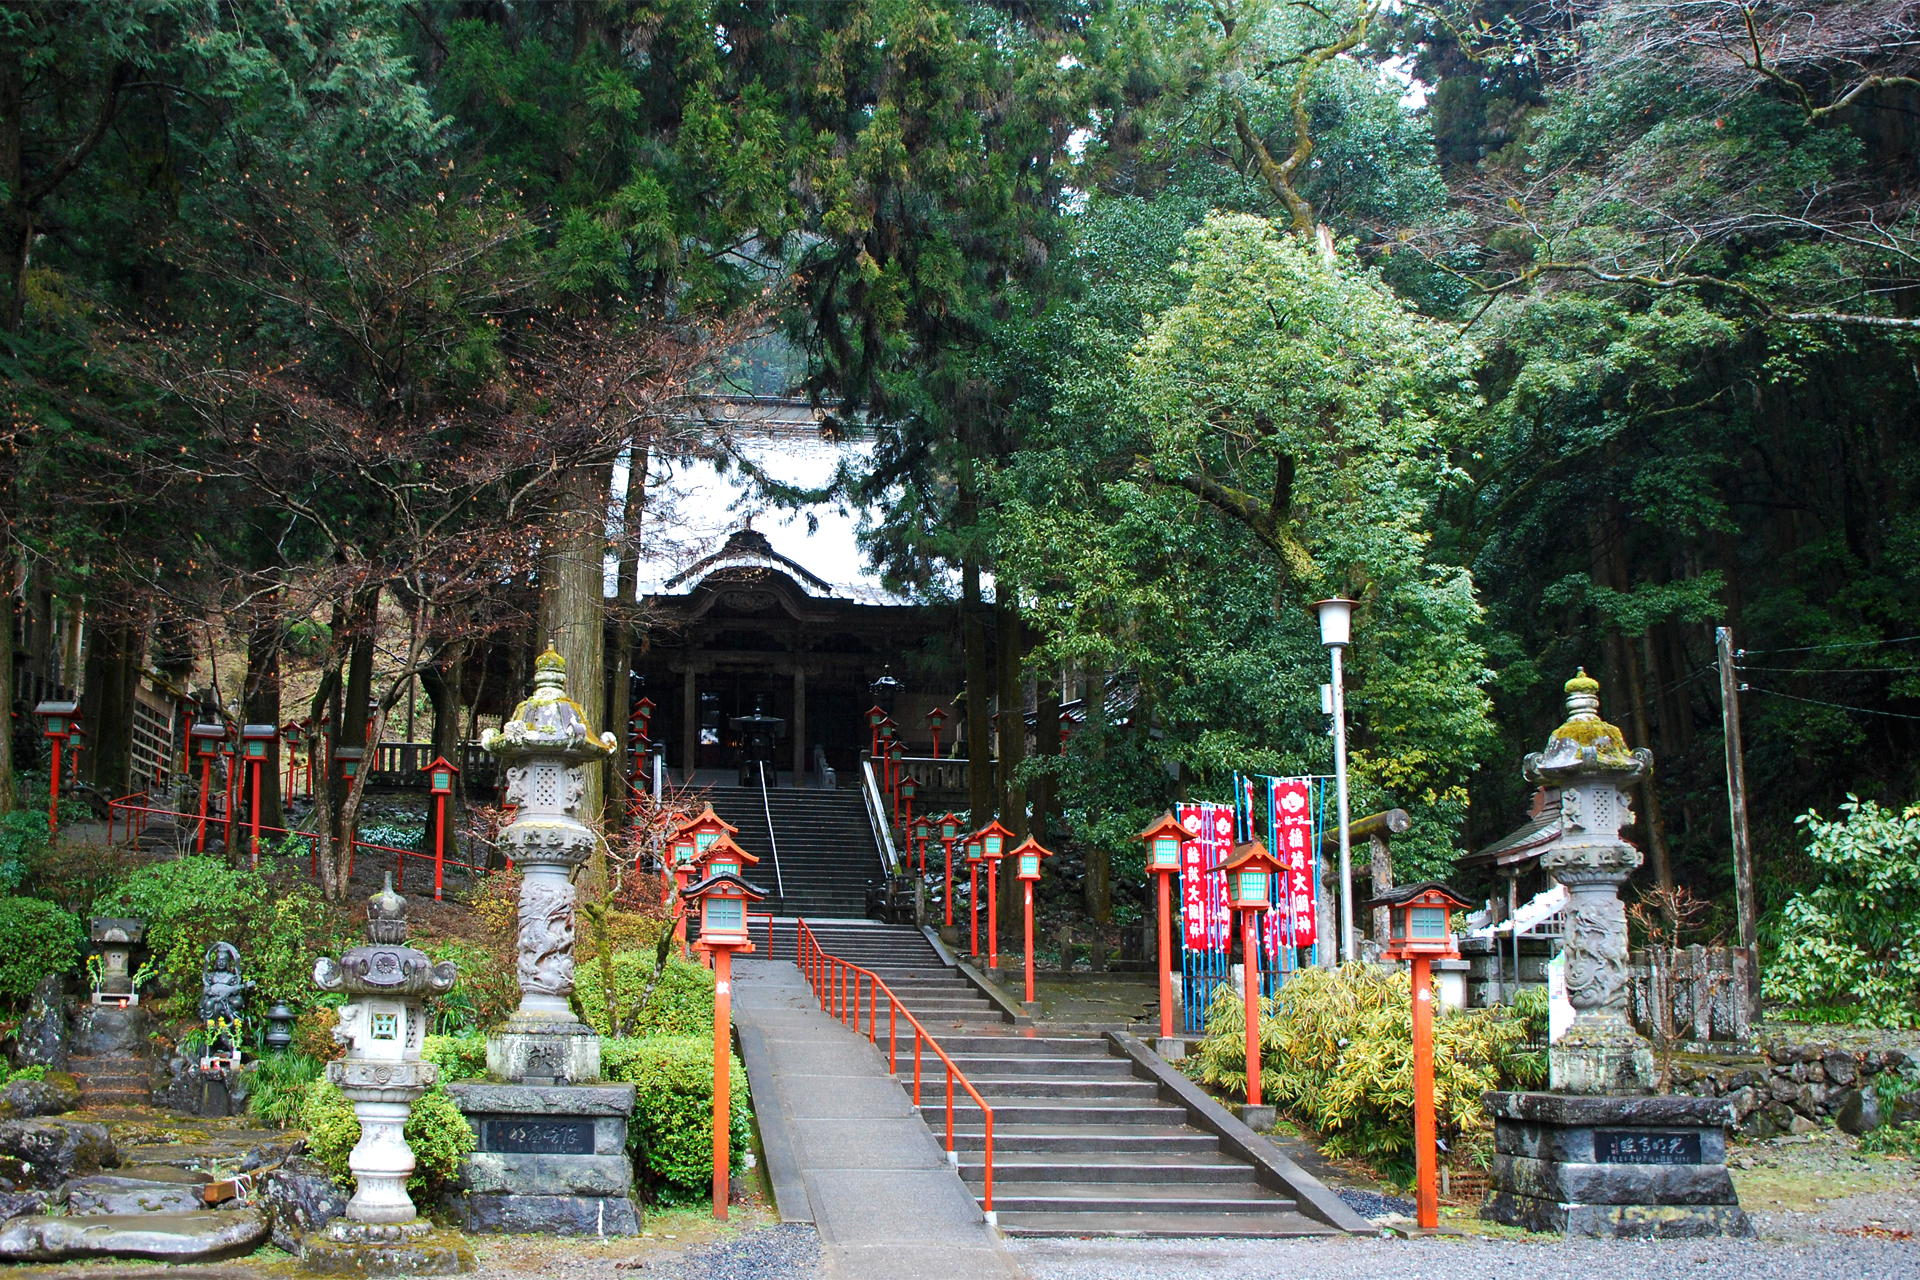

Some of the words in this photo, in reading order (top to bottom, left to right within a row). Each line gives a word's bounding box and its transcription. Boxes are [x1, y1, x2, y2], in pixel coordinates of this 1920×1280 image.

[1288, 828, 1312, 935] 稲荷大明神
